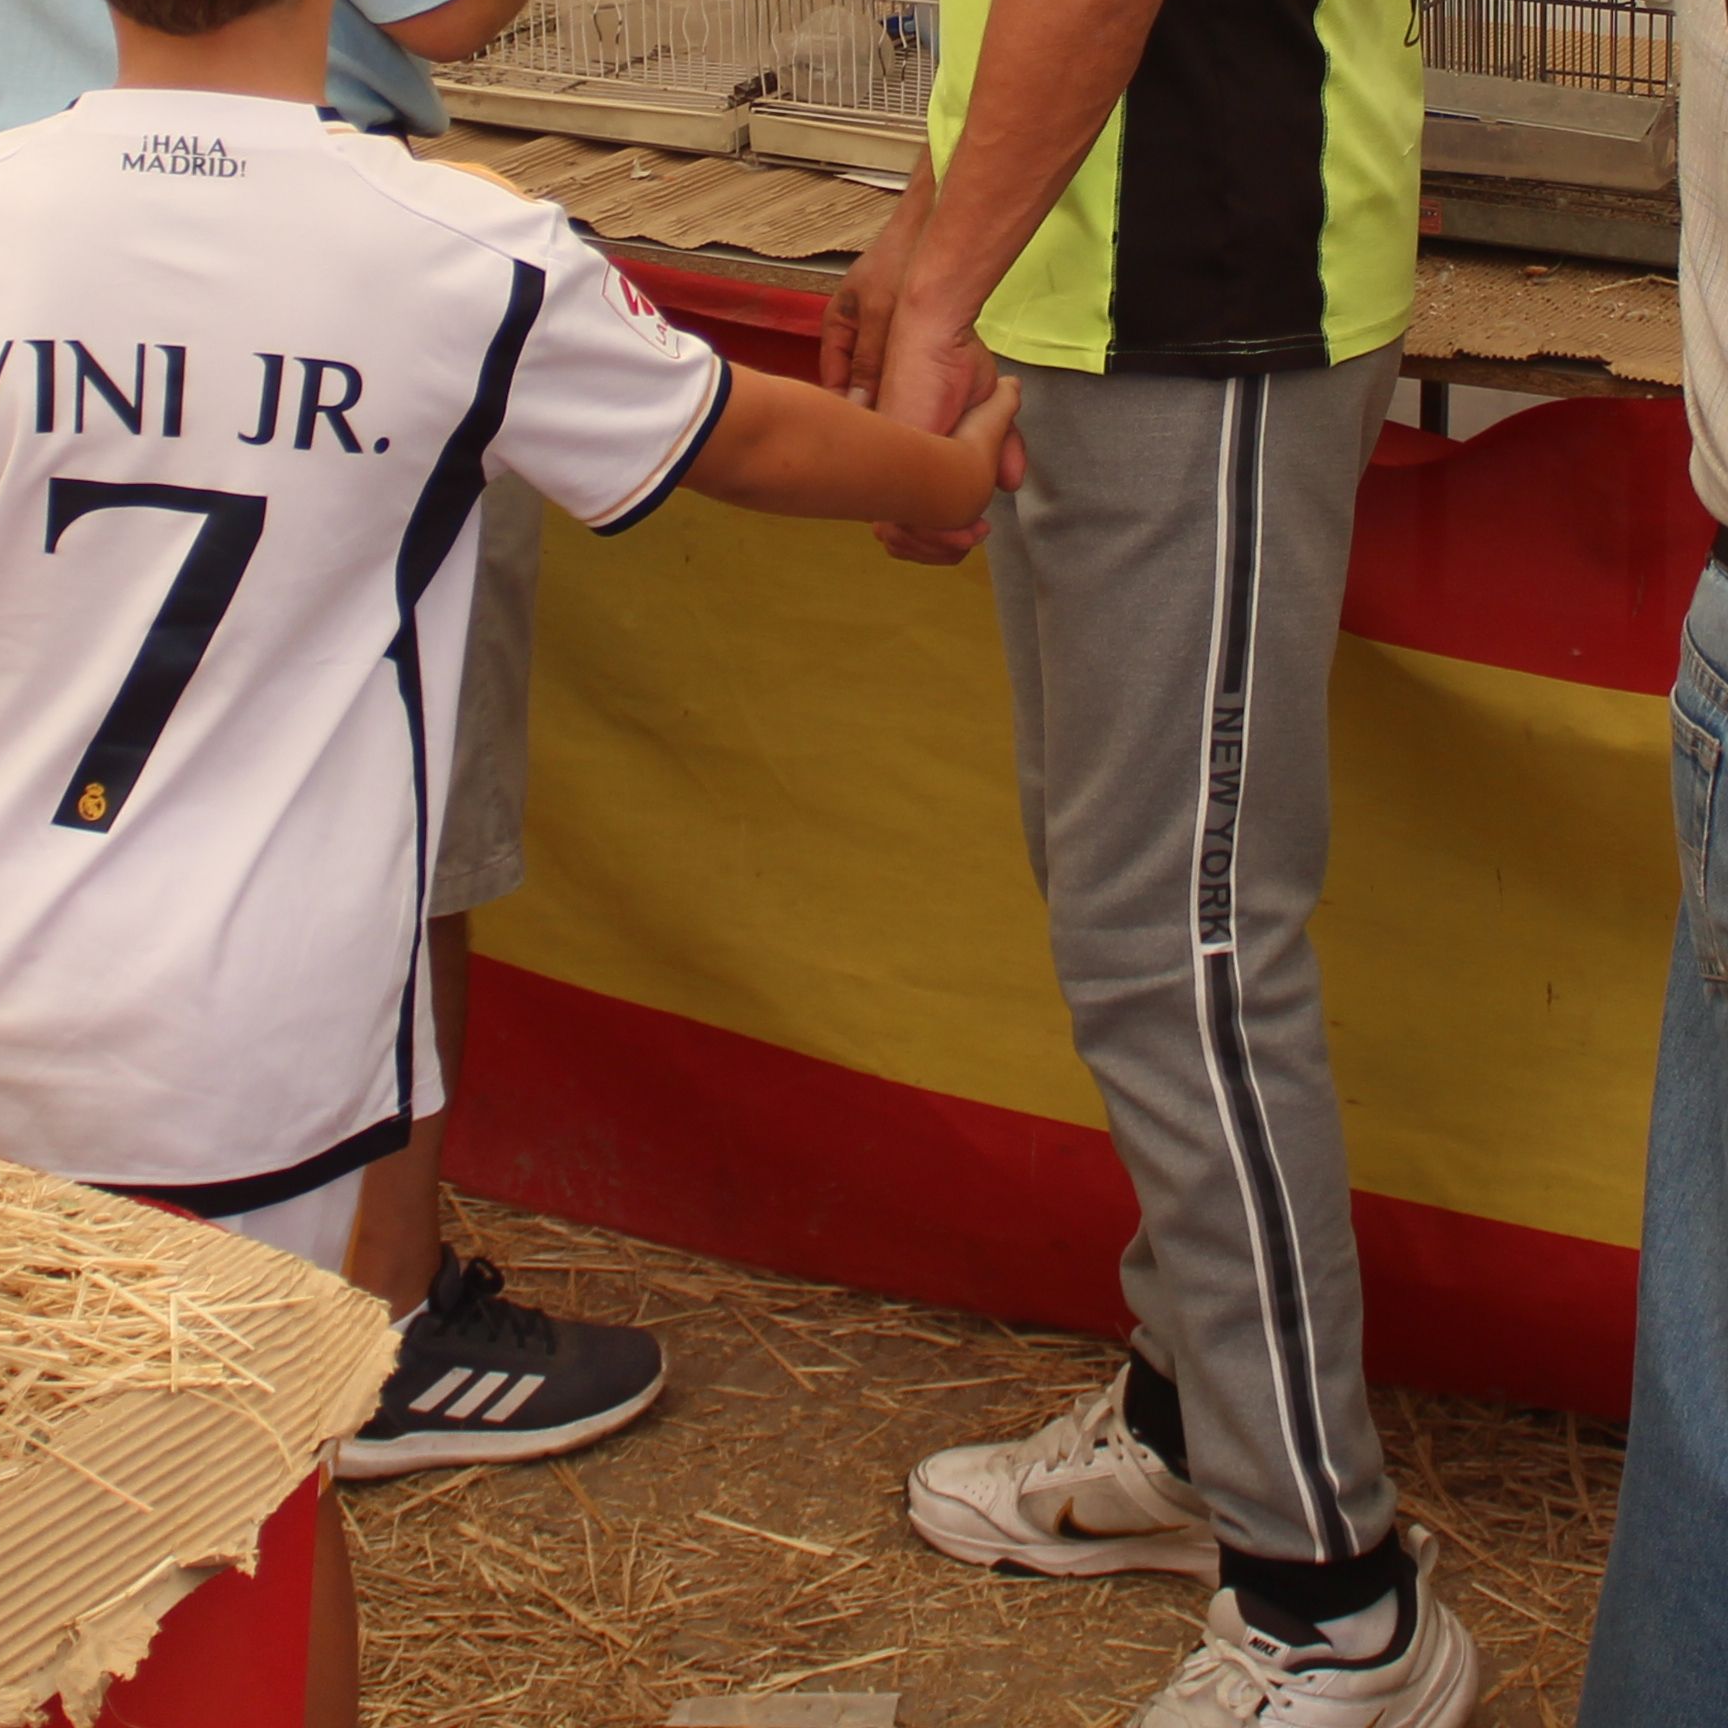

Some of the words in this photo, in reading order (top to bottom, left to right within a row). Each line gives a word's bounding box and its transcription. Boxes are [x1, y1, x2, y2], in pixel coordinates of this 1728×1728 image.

[122, 152, 248, 178] MADRID!
[142, 135, 227, 157] ¡HALA
[237, 351, 391, 455] JR.
[44, 476, 269, 835] 7
[1208, 706, 1245, 808] NEW
[1198, 817, 1238, 945] YORK
[1248, 1636, 1281, 1657] NIKE
